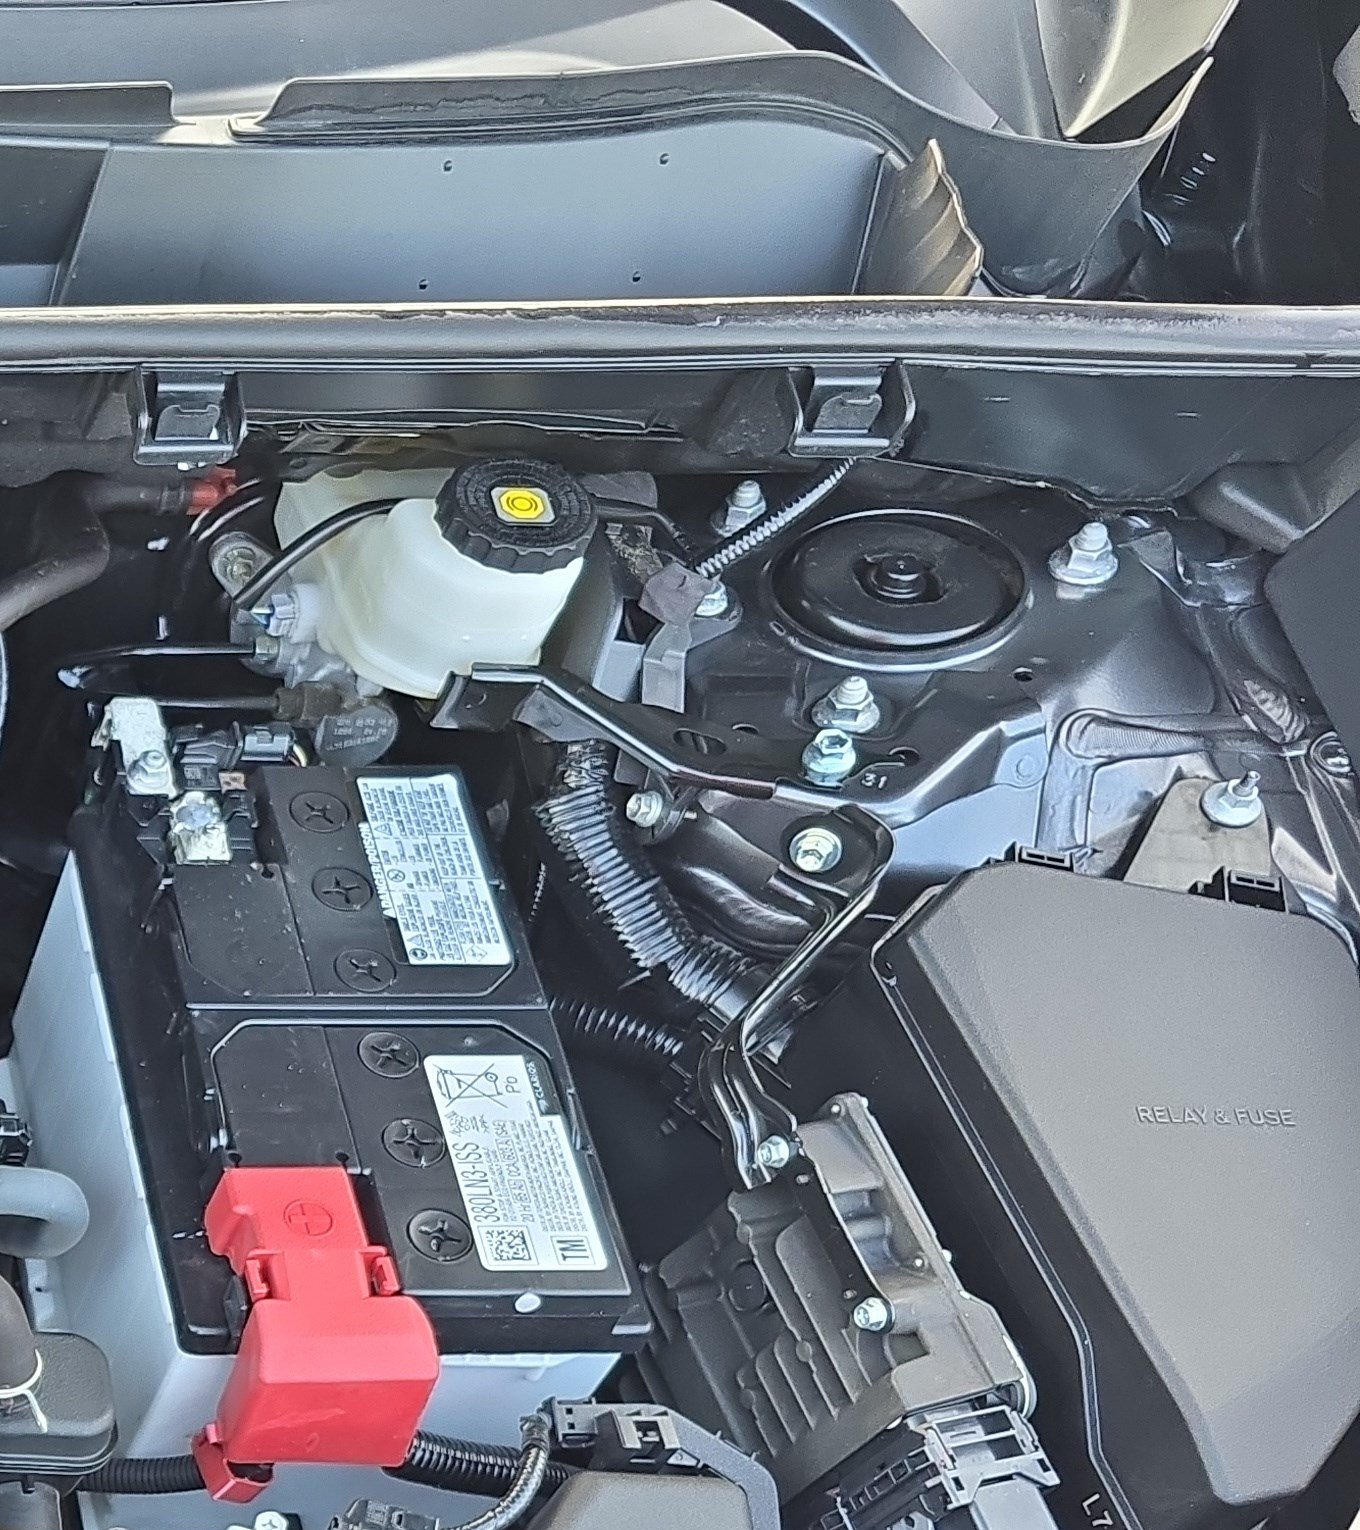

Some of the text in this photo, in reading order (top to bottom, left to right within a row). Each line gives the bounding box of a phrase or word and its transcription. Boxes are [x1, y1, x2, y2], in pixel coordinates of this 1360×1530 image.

[861, 772, 888, 789] 31
[1136, 1105, 1296, 1127] RELAY & FUSE
[452, 1141, 501, 1223] 380LN3-ISS
[556, 1239, 589, 1262] TM
[1082, 1493, 1114, 1527] L7
